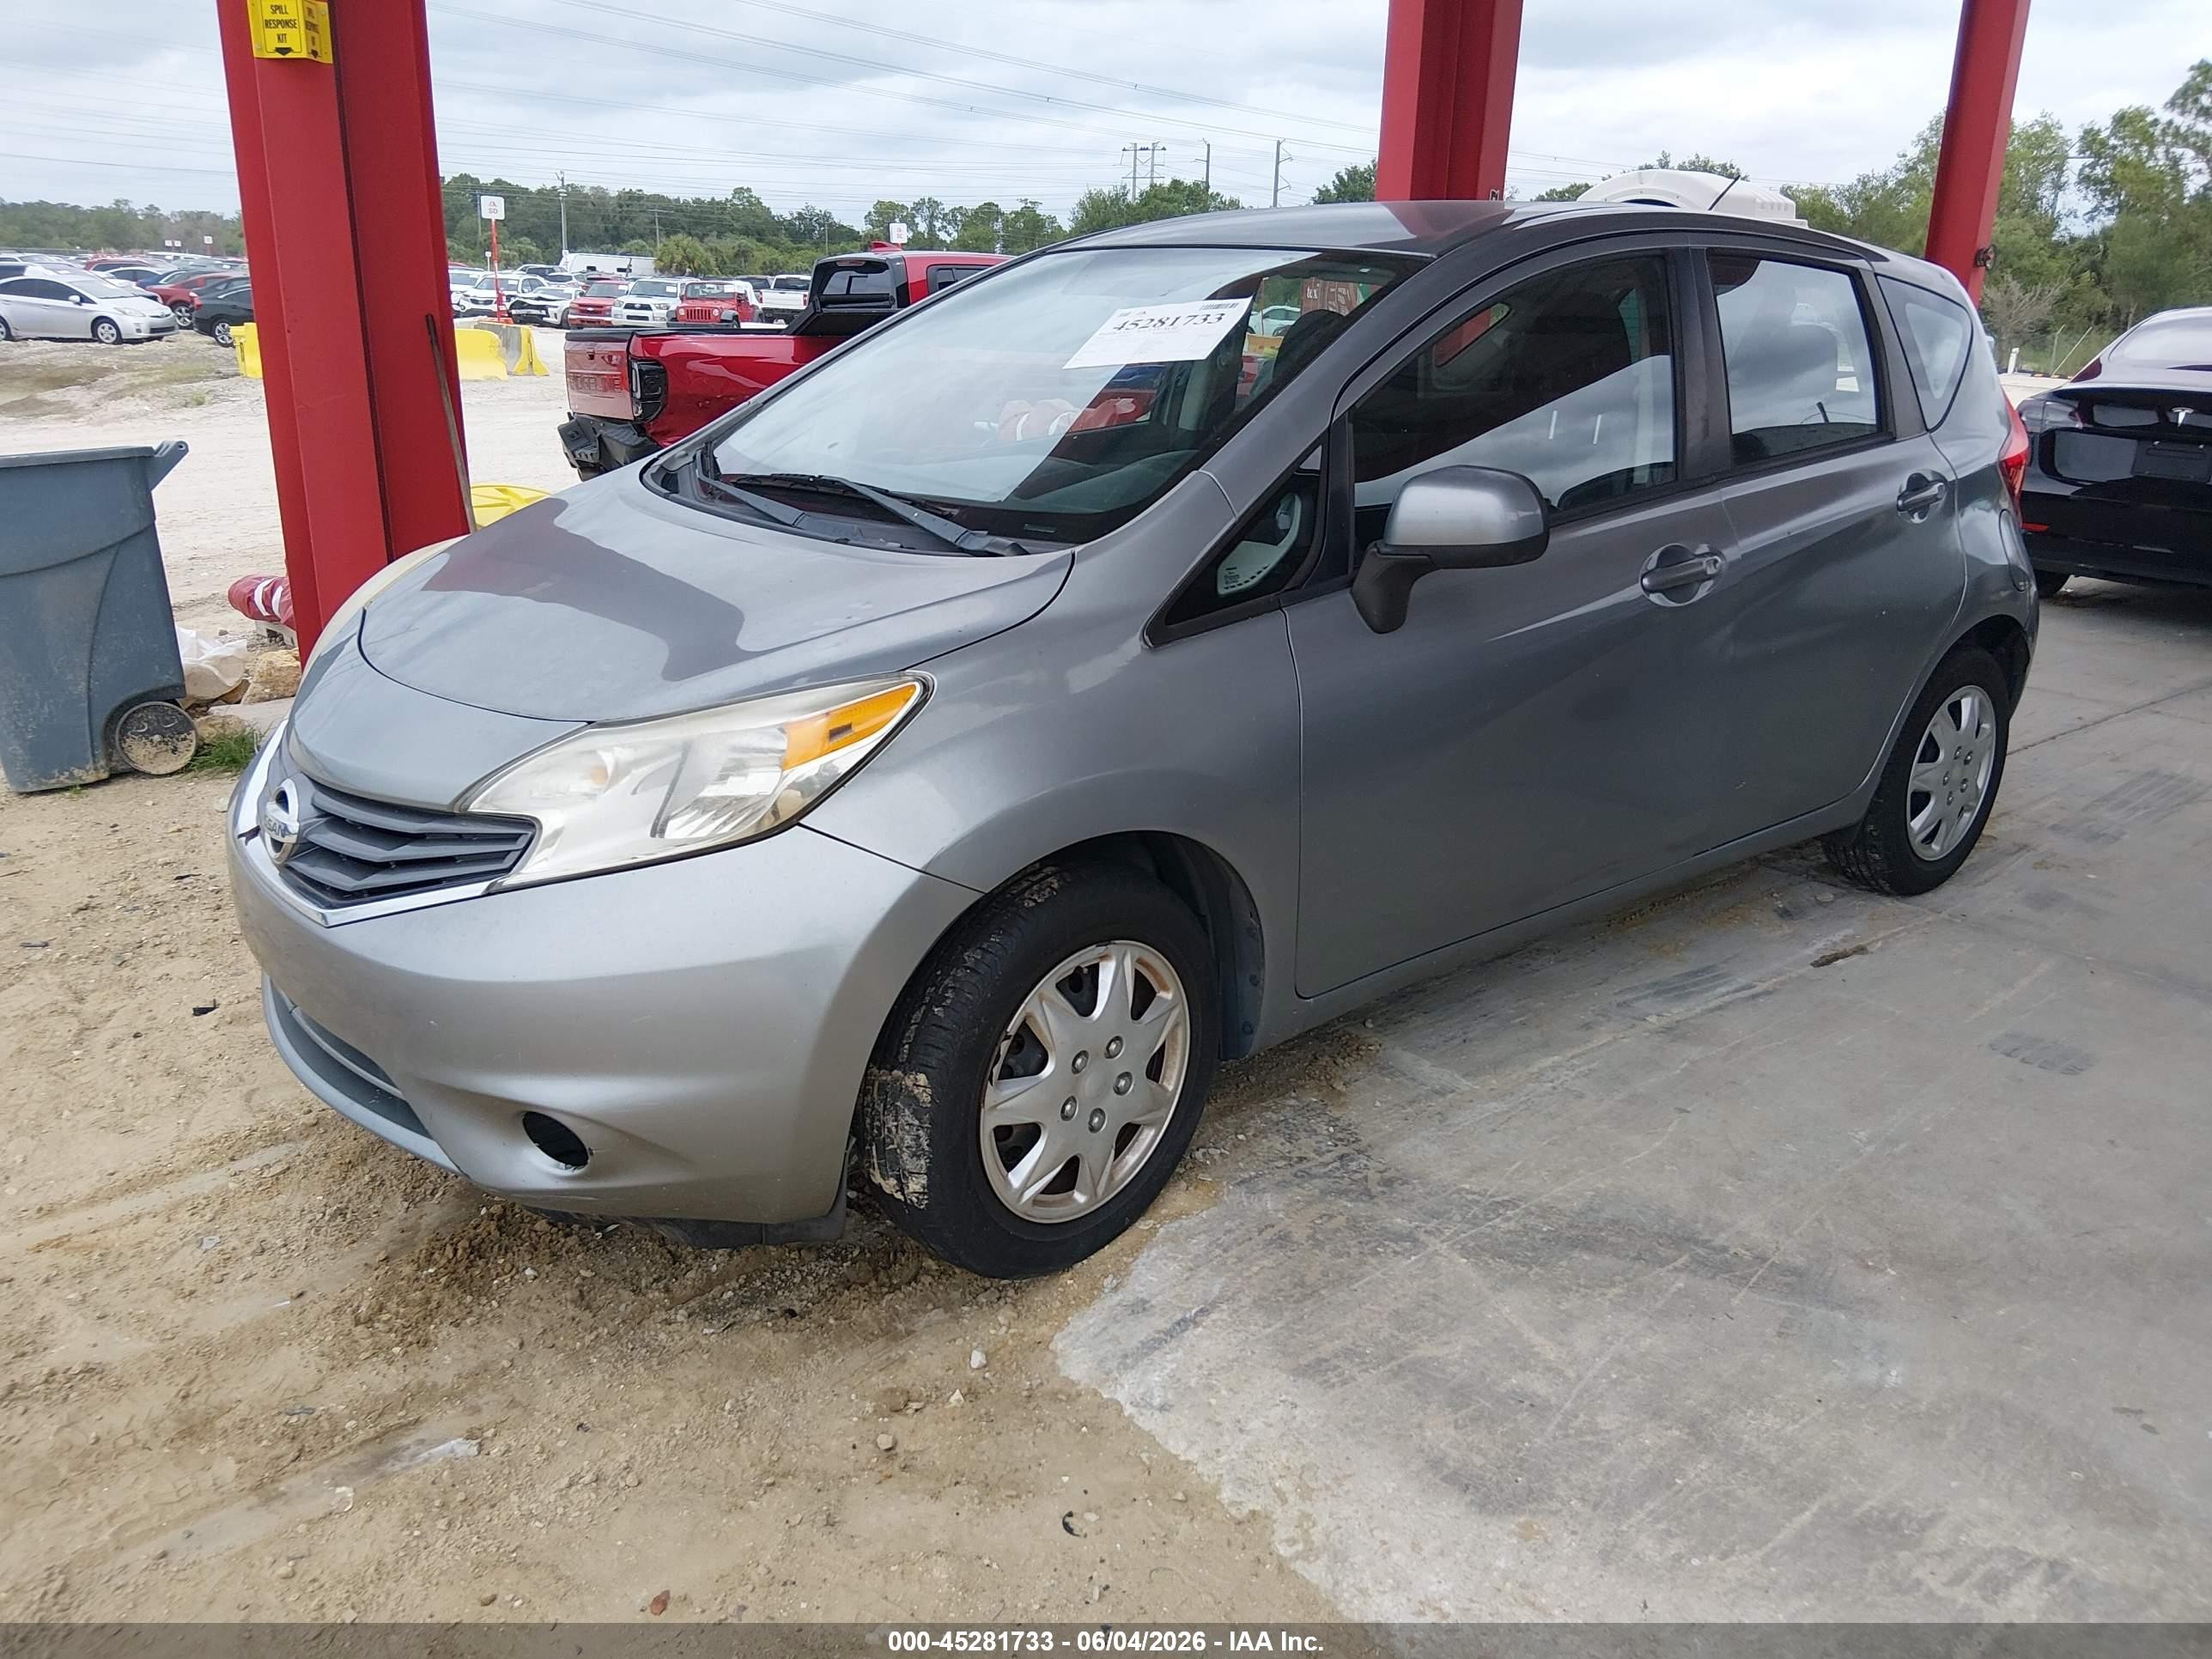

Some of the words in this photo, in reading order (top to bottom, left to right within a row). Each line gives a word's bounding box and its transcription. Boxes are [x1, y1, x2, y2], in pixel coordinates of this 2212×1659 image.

[270, 4, 289, 15] SPILL
[264, 19, 297, 28] RESPONSE
[276, 33, 288, 43] KIT
[1113, 312, 1225, 331] 45281733
